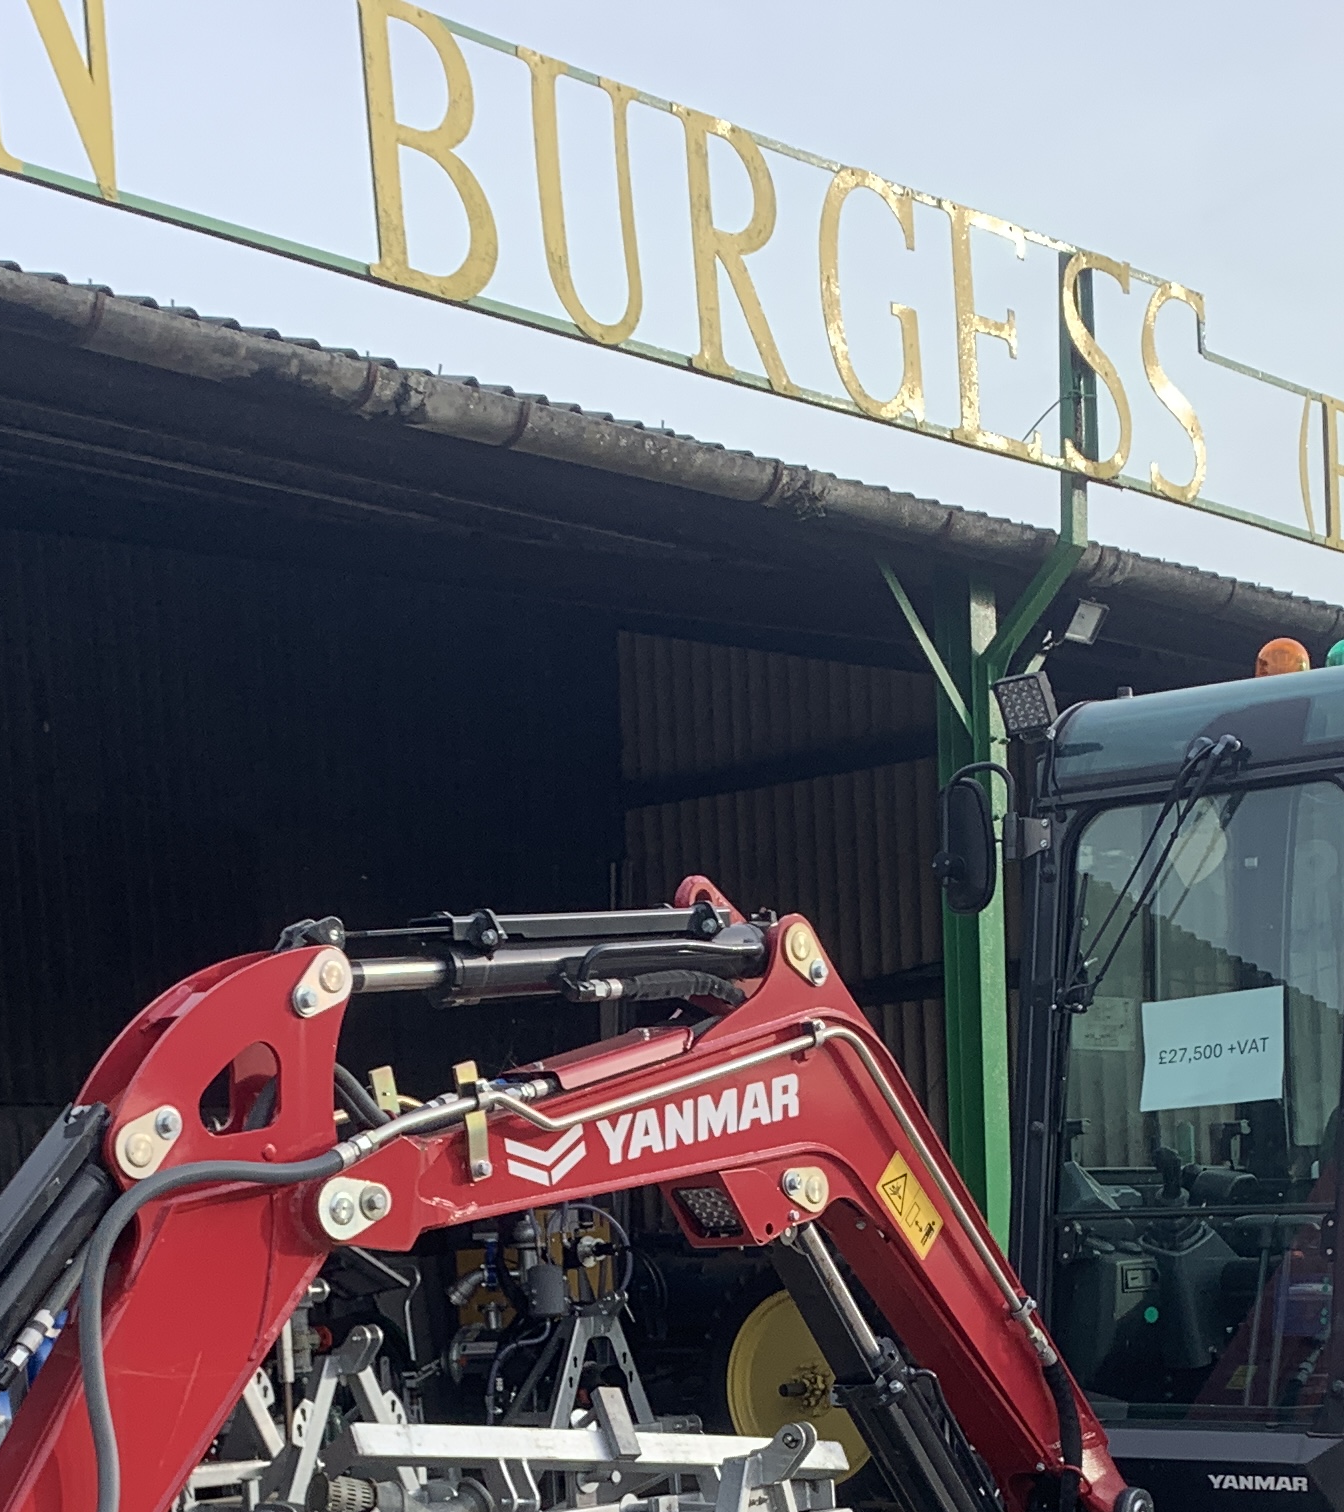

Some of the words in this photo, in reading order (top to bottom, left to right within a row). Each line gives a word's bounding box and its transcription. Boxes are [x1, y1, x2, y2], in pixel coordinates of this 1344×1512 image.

[359, 0, 1207, 502] BURGESS
[1158, 1043, 1223, 1065] £27,500
[1227, 1036, 1270, 1056] +VAT
[596, 1073, 799, 1164] YANMAR
[1207, 1474, 1308, 1492] YANMAR
